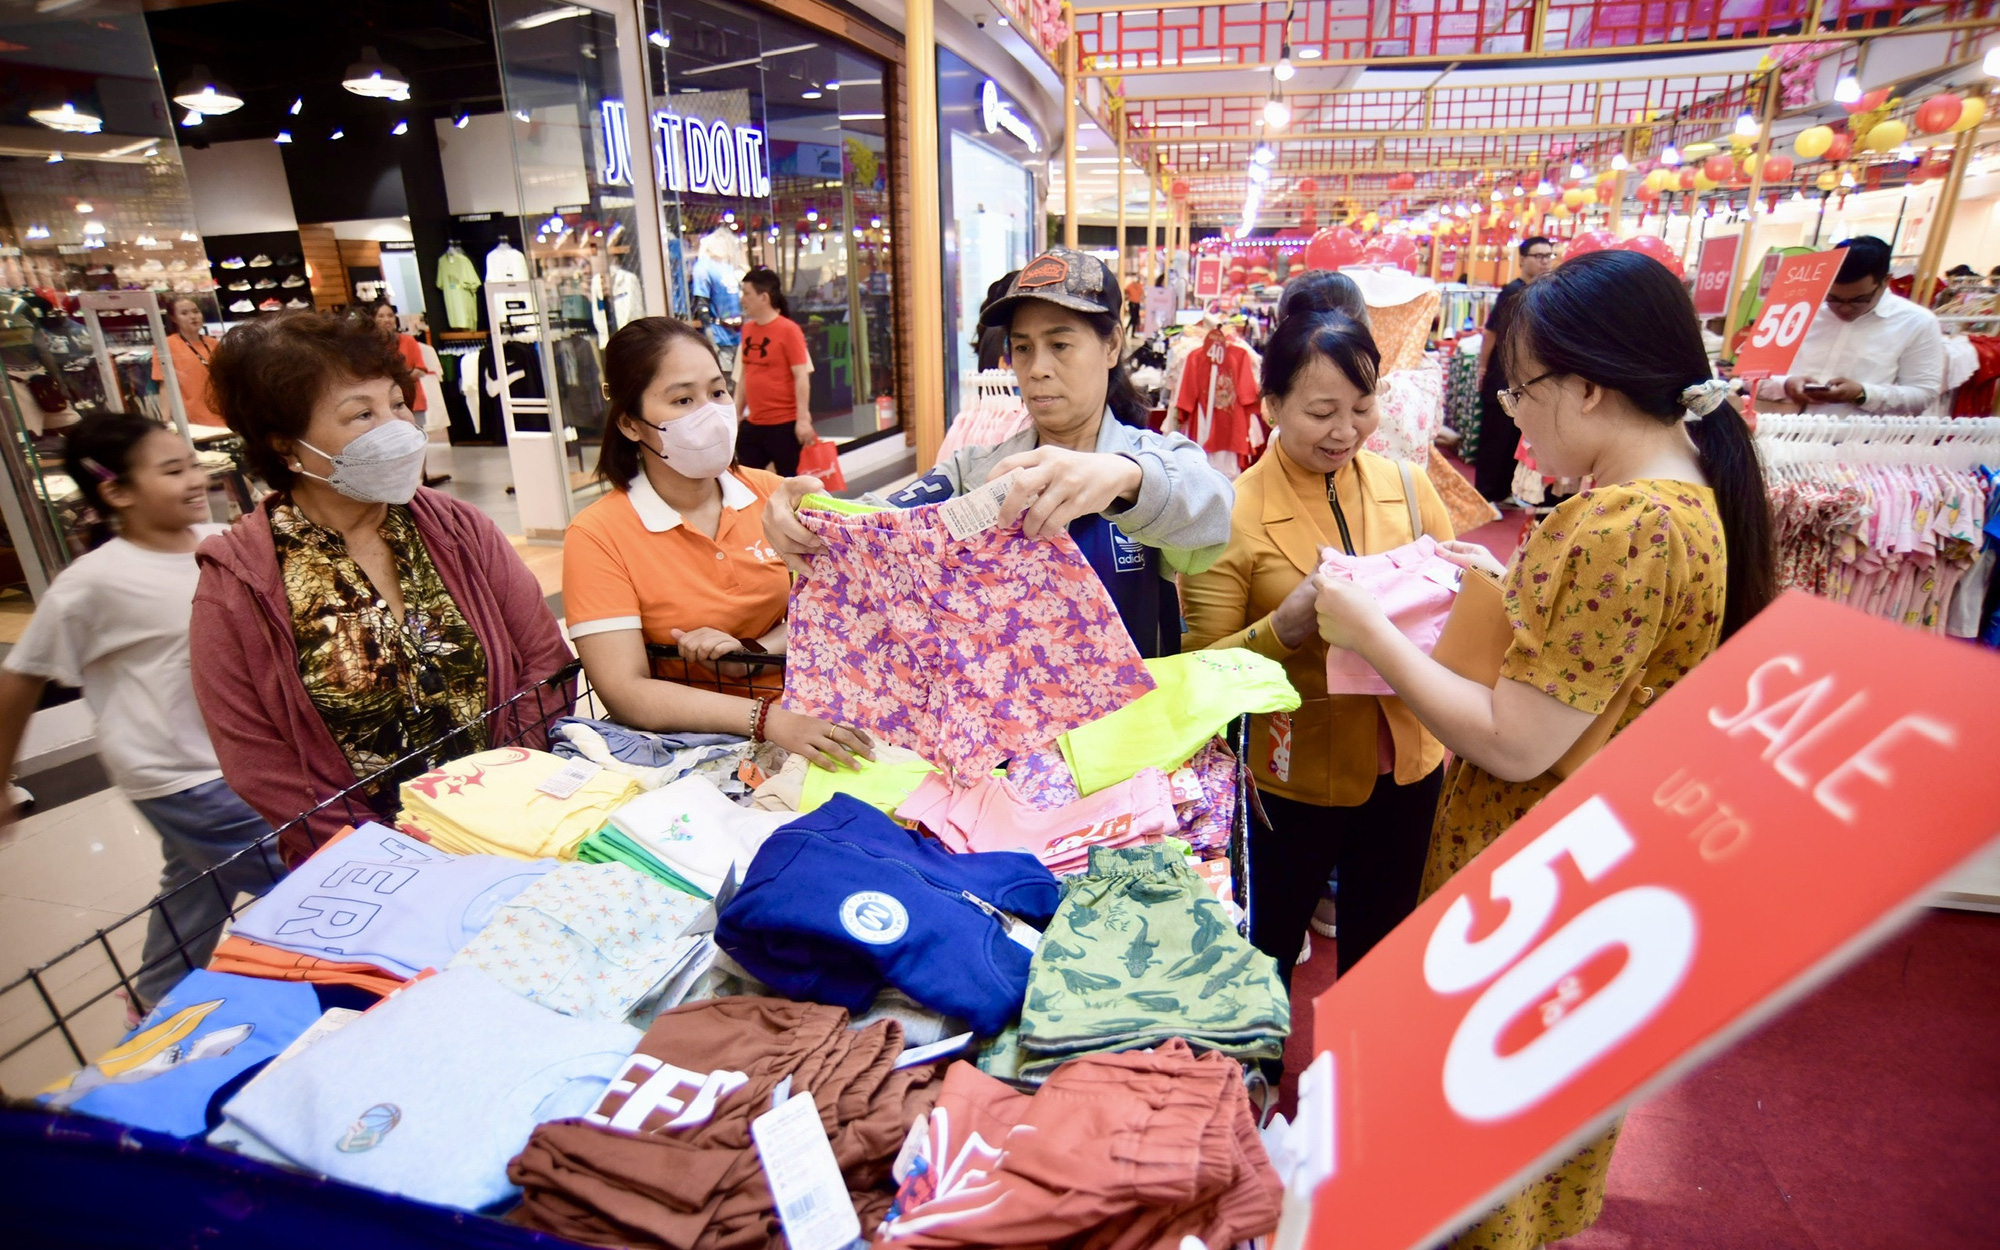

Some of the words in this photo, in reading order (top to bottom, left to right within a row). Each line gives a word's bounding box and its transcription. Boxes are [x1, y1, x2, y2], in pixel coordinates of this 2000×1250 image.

[602, 100, 682, 190] JUT
[685, 117, 737, 195] DO
[1784, 263, 1827, 284] SALE
[1206, 343, 1225, 364] 40
[1752, 302, 1811, 348] 50
[1708, 655, 1957, 826] SALE
[1653, 767, 1711, 816] UP
[1687, 801, 1751, 862] TO
[1422, 793, 1699, 1125] 50
